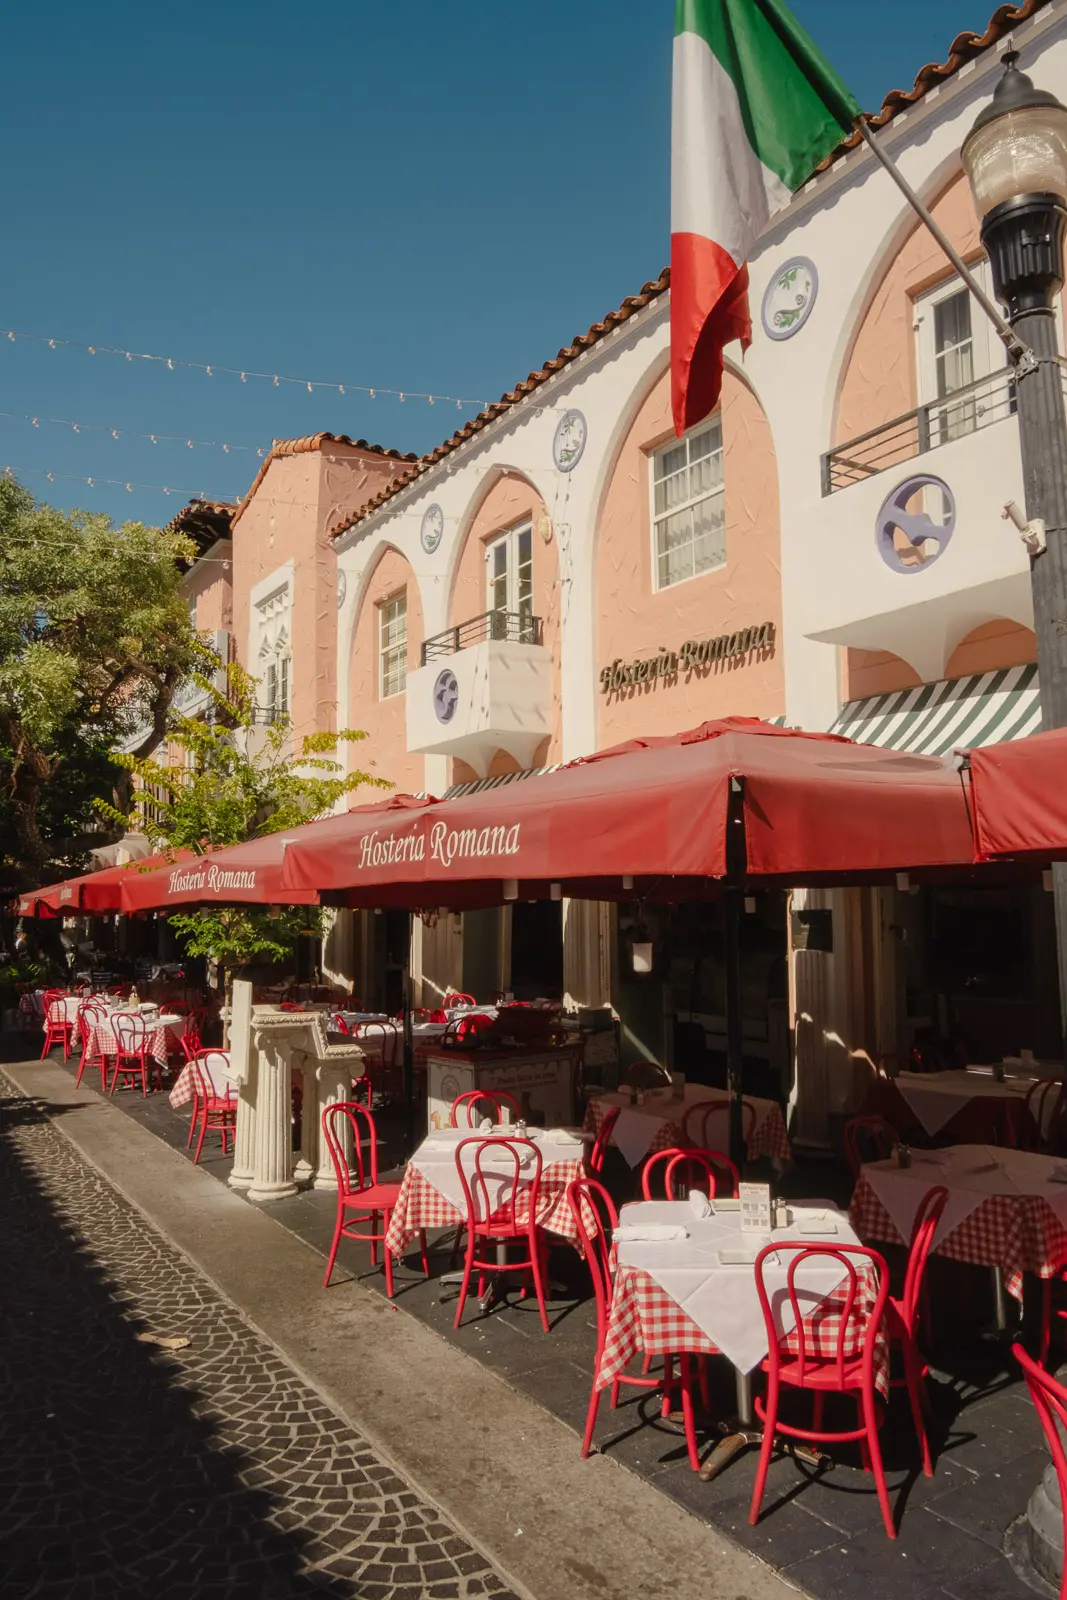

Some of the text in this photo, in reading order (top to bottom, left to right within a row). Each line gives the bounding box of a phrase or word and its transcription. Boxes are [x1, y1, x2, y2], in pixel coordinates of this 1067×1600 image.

[599, 621, 776, 694] Hosteria Romana
[358, 821, 521, 869] Hosteria Romana
[168, 865, 256, 894] Hosteria Romana
